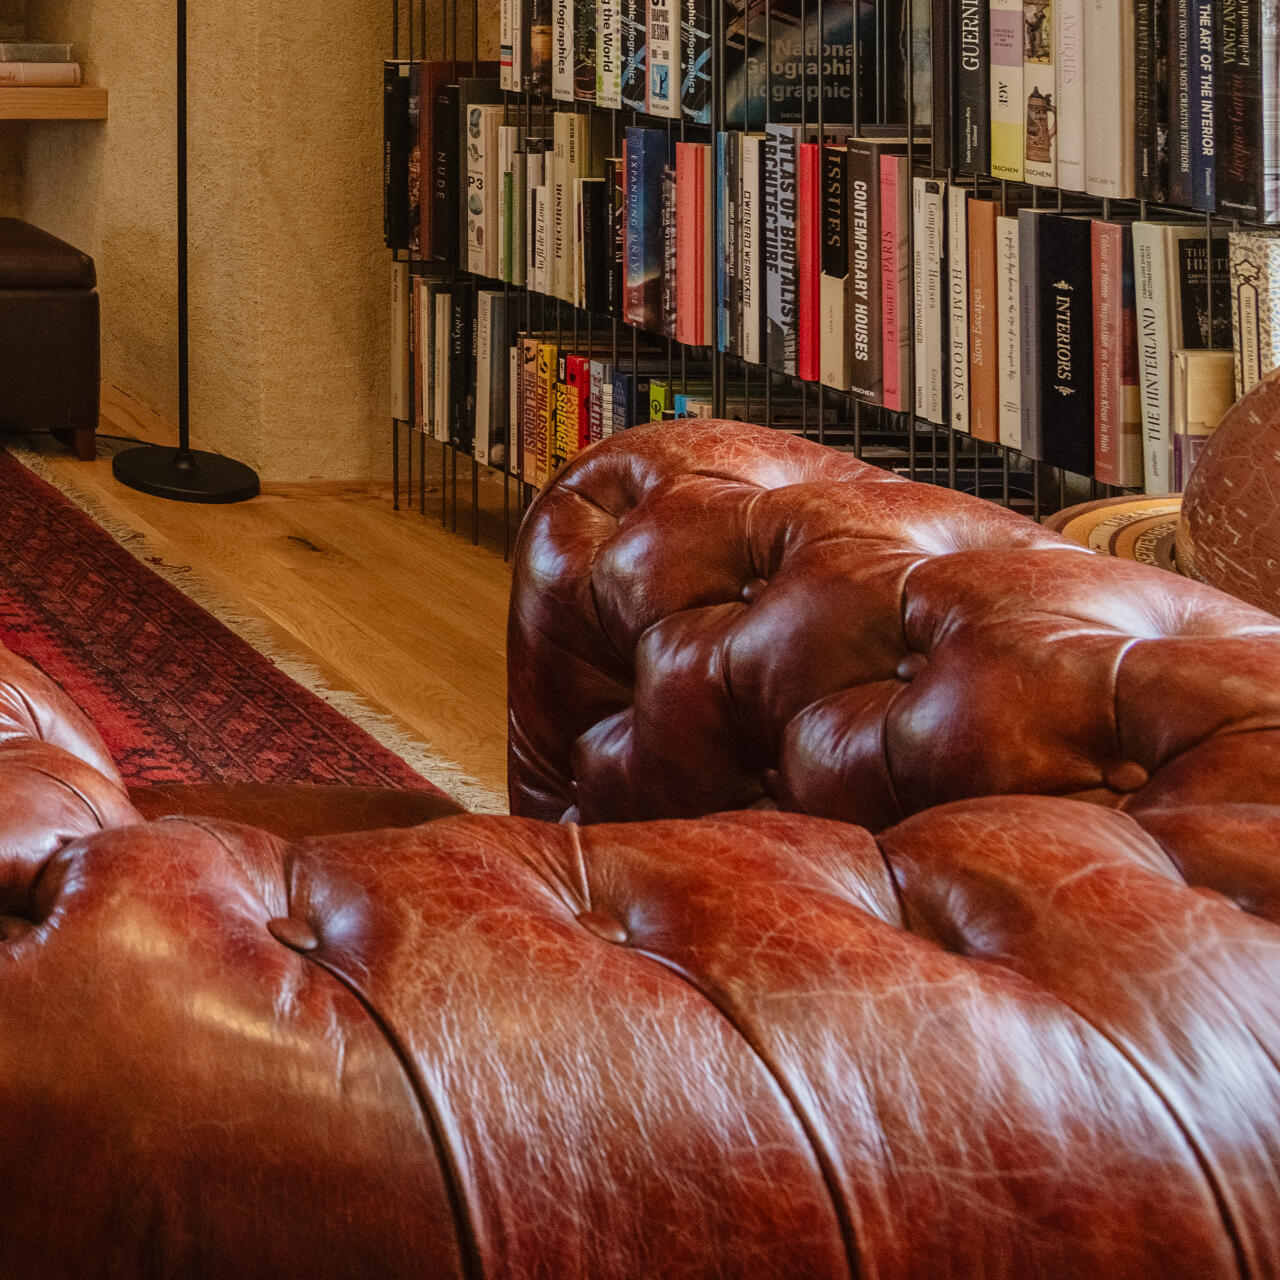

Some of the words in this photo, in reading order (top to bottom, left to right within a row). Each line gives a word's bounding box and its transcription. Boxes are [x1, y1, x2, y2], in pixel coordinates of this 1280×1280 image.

[603, 12, 613, 30] the
[1199, 3, 1211, 26] THE
[1223, 0, 1236, 24] ANS
[603, 32, 613, 73] World
[1199, 26, 1212, 52] ART
[1200, 54, 1212, 71] OF
[1223, 25, 1237, 64] VINGT
[998, 81, 1008, 108] AGE
[1200, 74, 1212, 98] THE
[1200, 100, 1214, 156] INTERIOR
[437, 151, 446, 200] NUDE
[779, 132, 795, 193] ATLAS
[765, 131, 779, 274] ARCHITECTURE
[780, 197, 796, 222] OF
[827, 155, 841, 247] ISSUES
[853, 180, 868, 301] CONTEMPORARY
[780, 225, 796, 328] BRUTALIST
[928, 267, 939, 310] Houses
[952, 269, 963, 323] HOME
[855, 306, 868, 362] HOUSES
[974, 288, 984, 333] Escapes
[972, 336, 983, 366] Slow
[1056, 296, 1071, 380] INTERIORS
[1142, 307, 1159, 408] HINTERLAND
[954, 340, 964, 401] BOOKS
[524, 379, 536, 449] RELIGIONS
[537, 384, 548, 465] PHILOSOPHY
[556, 389, 568, 453] SCIENCE
[1148, 410, 1161, 443] THE
